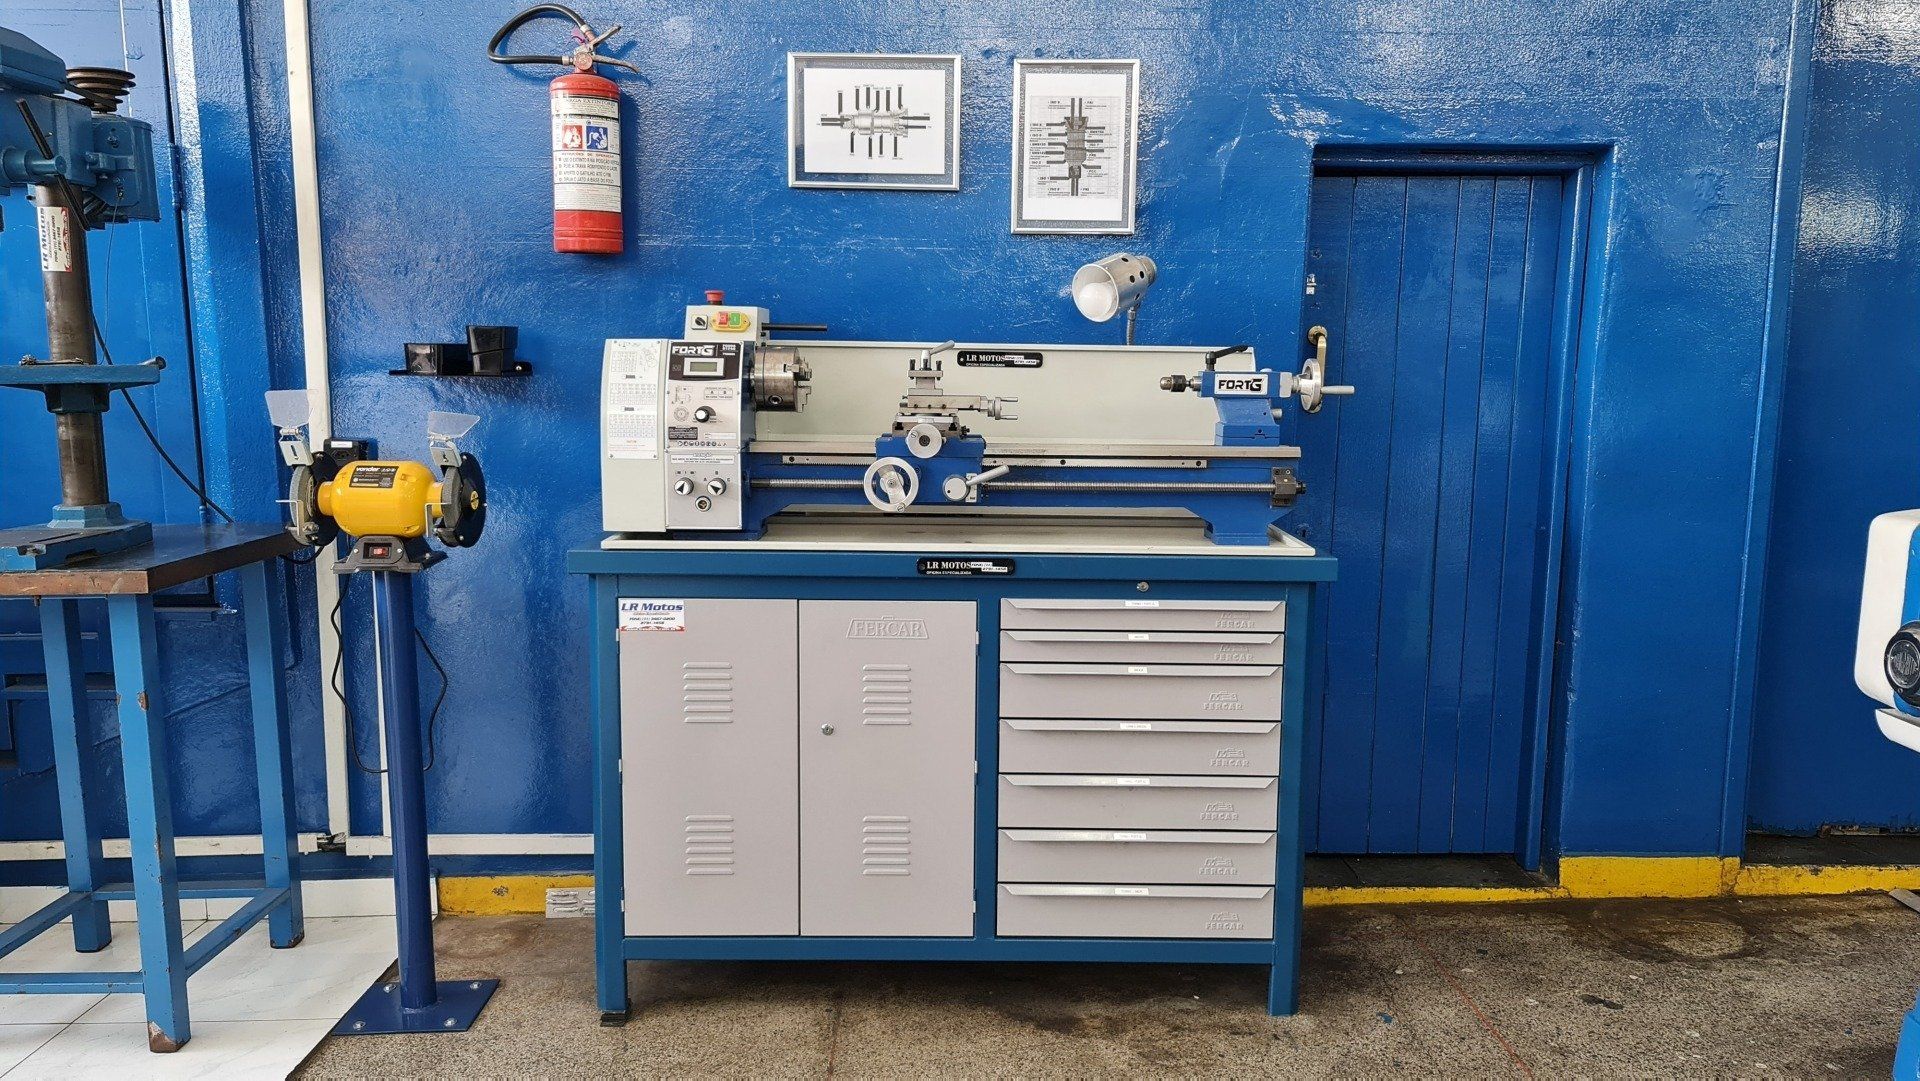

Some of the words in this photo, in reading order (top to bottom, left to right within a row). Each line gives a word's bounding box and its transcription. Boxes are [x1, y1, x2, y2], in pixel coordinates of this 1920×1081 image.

[978, 354, 1005, 362] MOTOS
[926, 561, 939, 569] LR
[941, 561, 971, 569] MOTOS
[621, 602, 638, 611] LR
[641, 602, 683, 611] Motos
[853, 620, 921, 637] FERCAR
